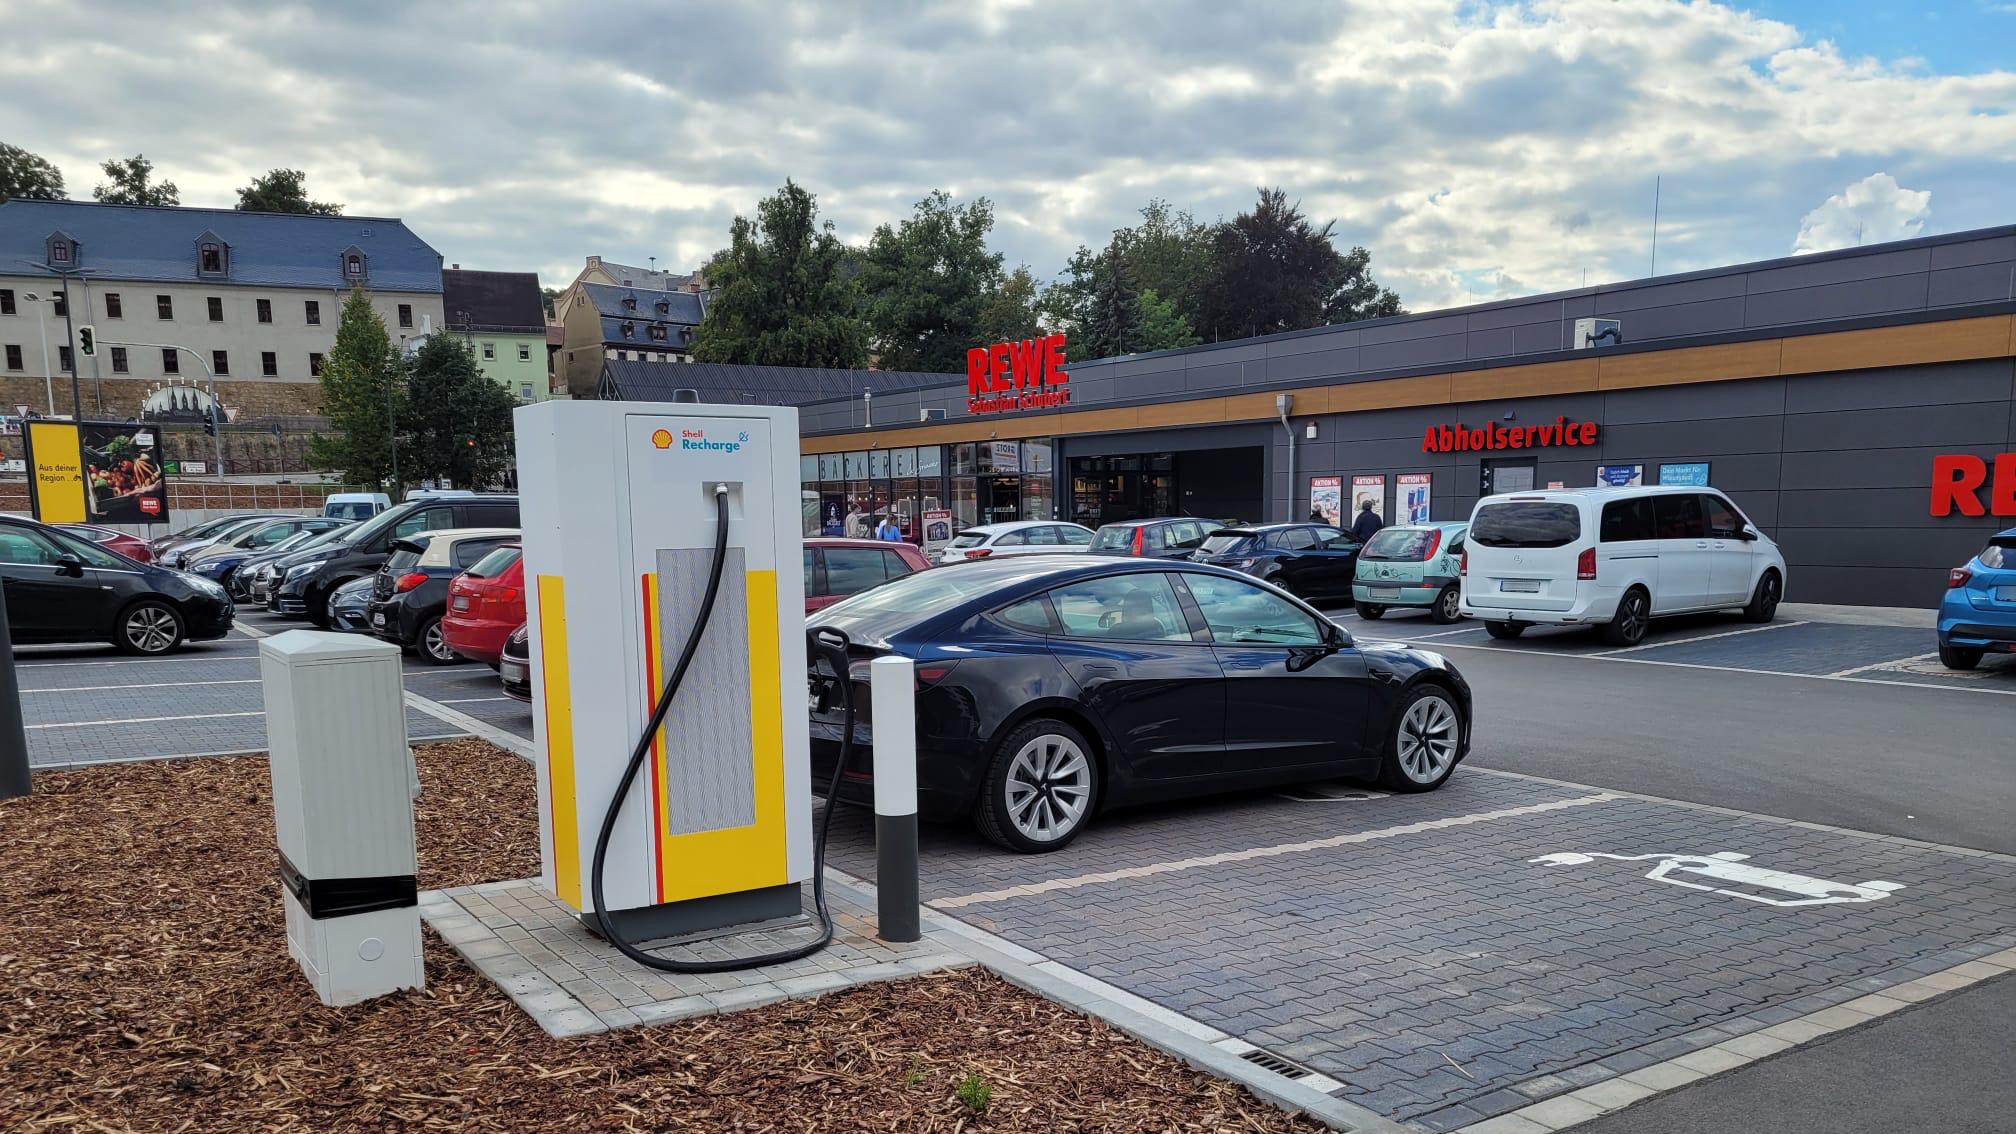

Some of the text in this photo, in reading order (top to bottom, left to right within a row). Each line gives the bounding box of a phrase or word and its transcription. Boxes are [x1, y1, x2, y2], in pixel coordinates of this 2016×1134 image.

[967, 333, 1069, 395] REWE
[967, 395, 1018, 415] Sebastian
[682, 429, 703, 438] Shell
[1422, 415, 1597, 453] Abholservice
[682, 439, 740, 453] Recharge
[39, 463, 77, 472] Aus deiner
[820, 451, 914, 480] BÄCKEREI
[1314, 478, 1338, 487] AKTION %
[1355, 476, 1381, 485] AKTION %
[1400, 474, 1427, 484] AKTION %
